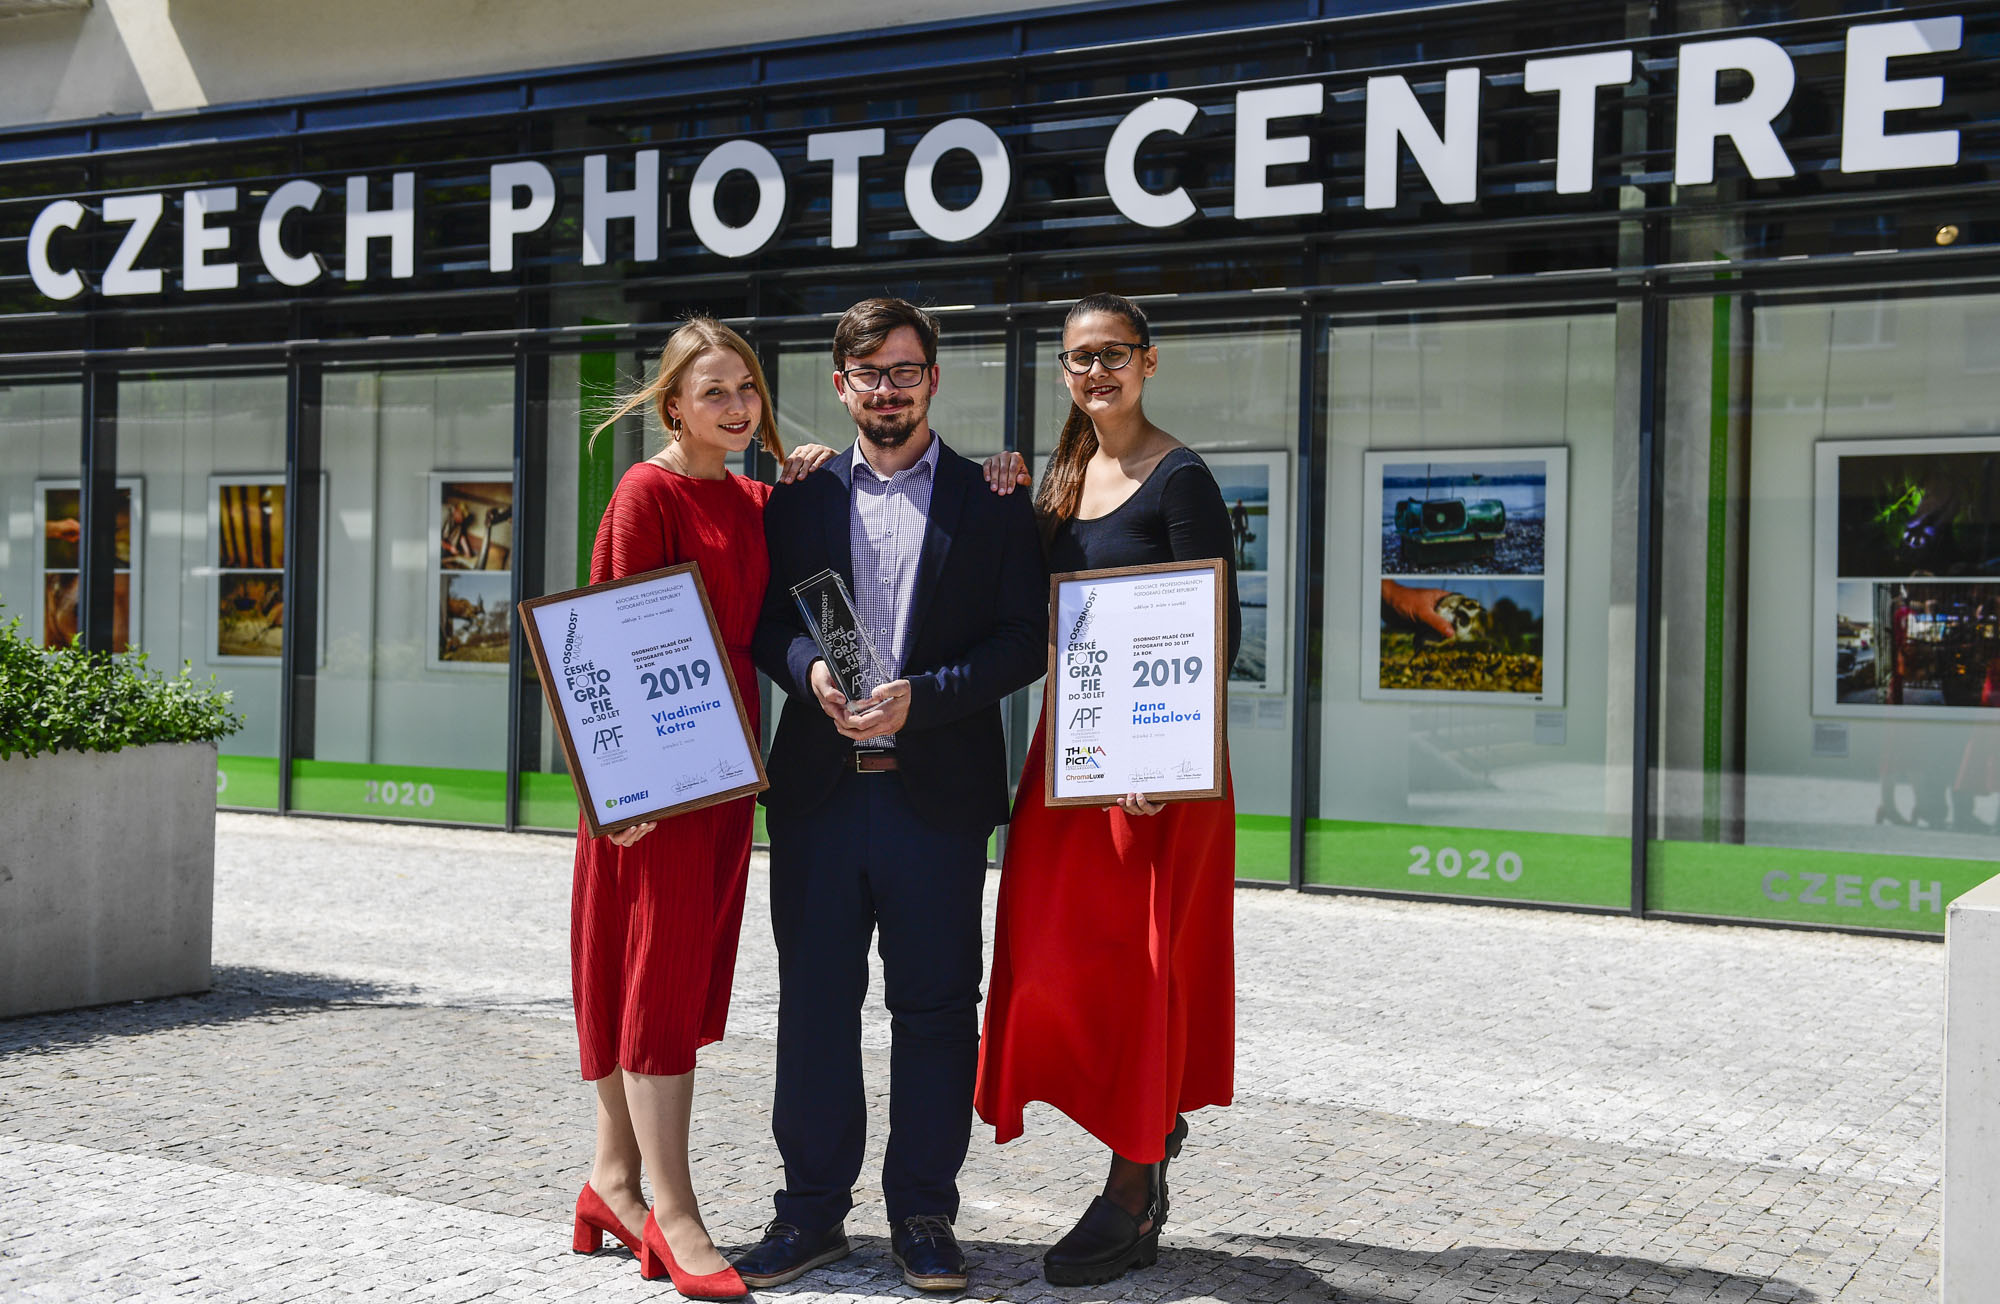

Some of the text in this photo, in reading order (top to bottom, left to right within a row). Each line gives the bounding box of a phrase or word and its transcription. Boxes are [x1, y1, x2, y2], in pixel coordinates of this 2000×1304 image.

[28, 16, 1962, 300] CZECH PHOTO CENTRE
[631, 645, 659, 656] OSOBNOST
[660, 640, 676, 649] MLADÉ
[833, 642, 858, 659] GRA
[1068, 639, 1096, 651] ČESKÉ
[633, 652, 664, 663] FOTOGRAFIE
[845, 650, 862, 665] FIE
[1067, 650, 1108, 665] FOTO
[564, 660, 595, 676] ČESKÉ
[841, 667, 850, 675] DO
[1069, 664, 1102, 678] GRA
[1132, 656, 1203, 688] 2019
[566, 669, 611, 691] FOTO
[641, 659, 710, 701] 2019
[1081, 678, 1100, 691] FIE
[574, 684, 611, 702] GRA
[590, 698, 613, 714] FIE
[651, 700, 721, 724] Vladimíra
[1132, 701, 1165, 712] Jana
[582, 710, 620, 725] DO 30 LET
[1069, 707, 1102, 729] APF
[1132, 709, 1201, 725] Habalová
[656, 720, 696, 736] Kotra
[593, 725, 623, 754] APF
[1065, 745, 1106, 756] THALIA
[1066, 756, 1100, 768] PICTA
[1066, 773, 1104, 781] ChromaLuxe
[365, 780, 434, 807] 2020
[619, 790, 649, 805] FOMEI
[1408, 845, 1523, 882] 2020
[1761, 869, 1942, 913] CZECH
